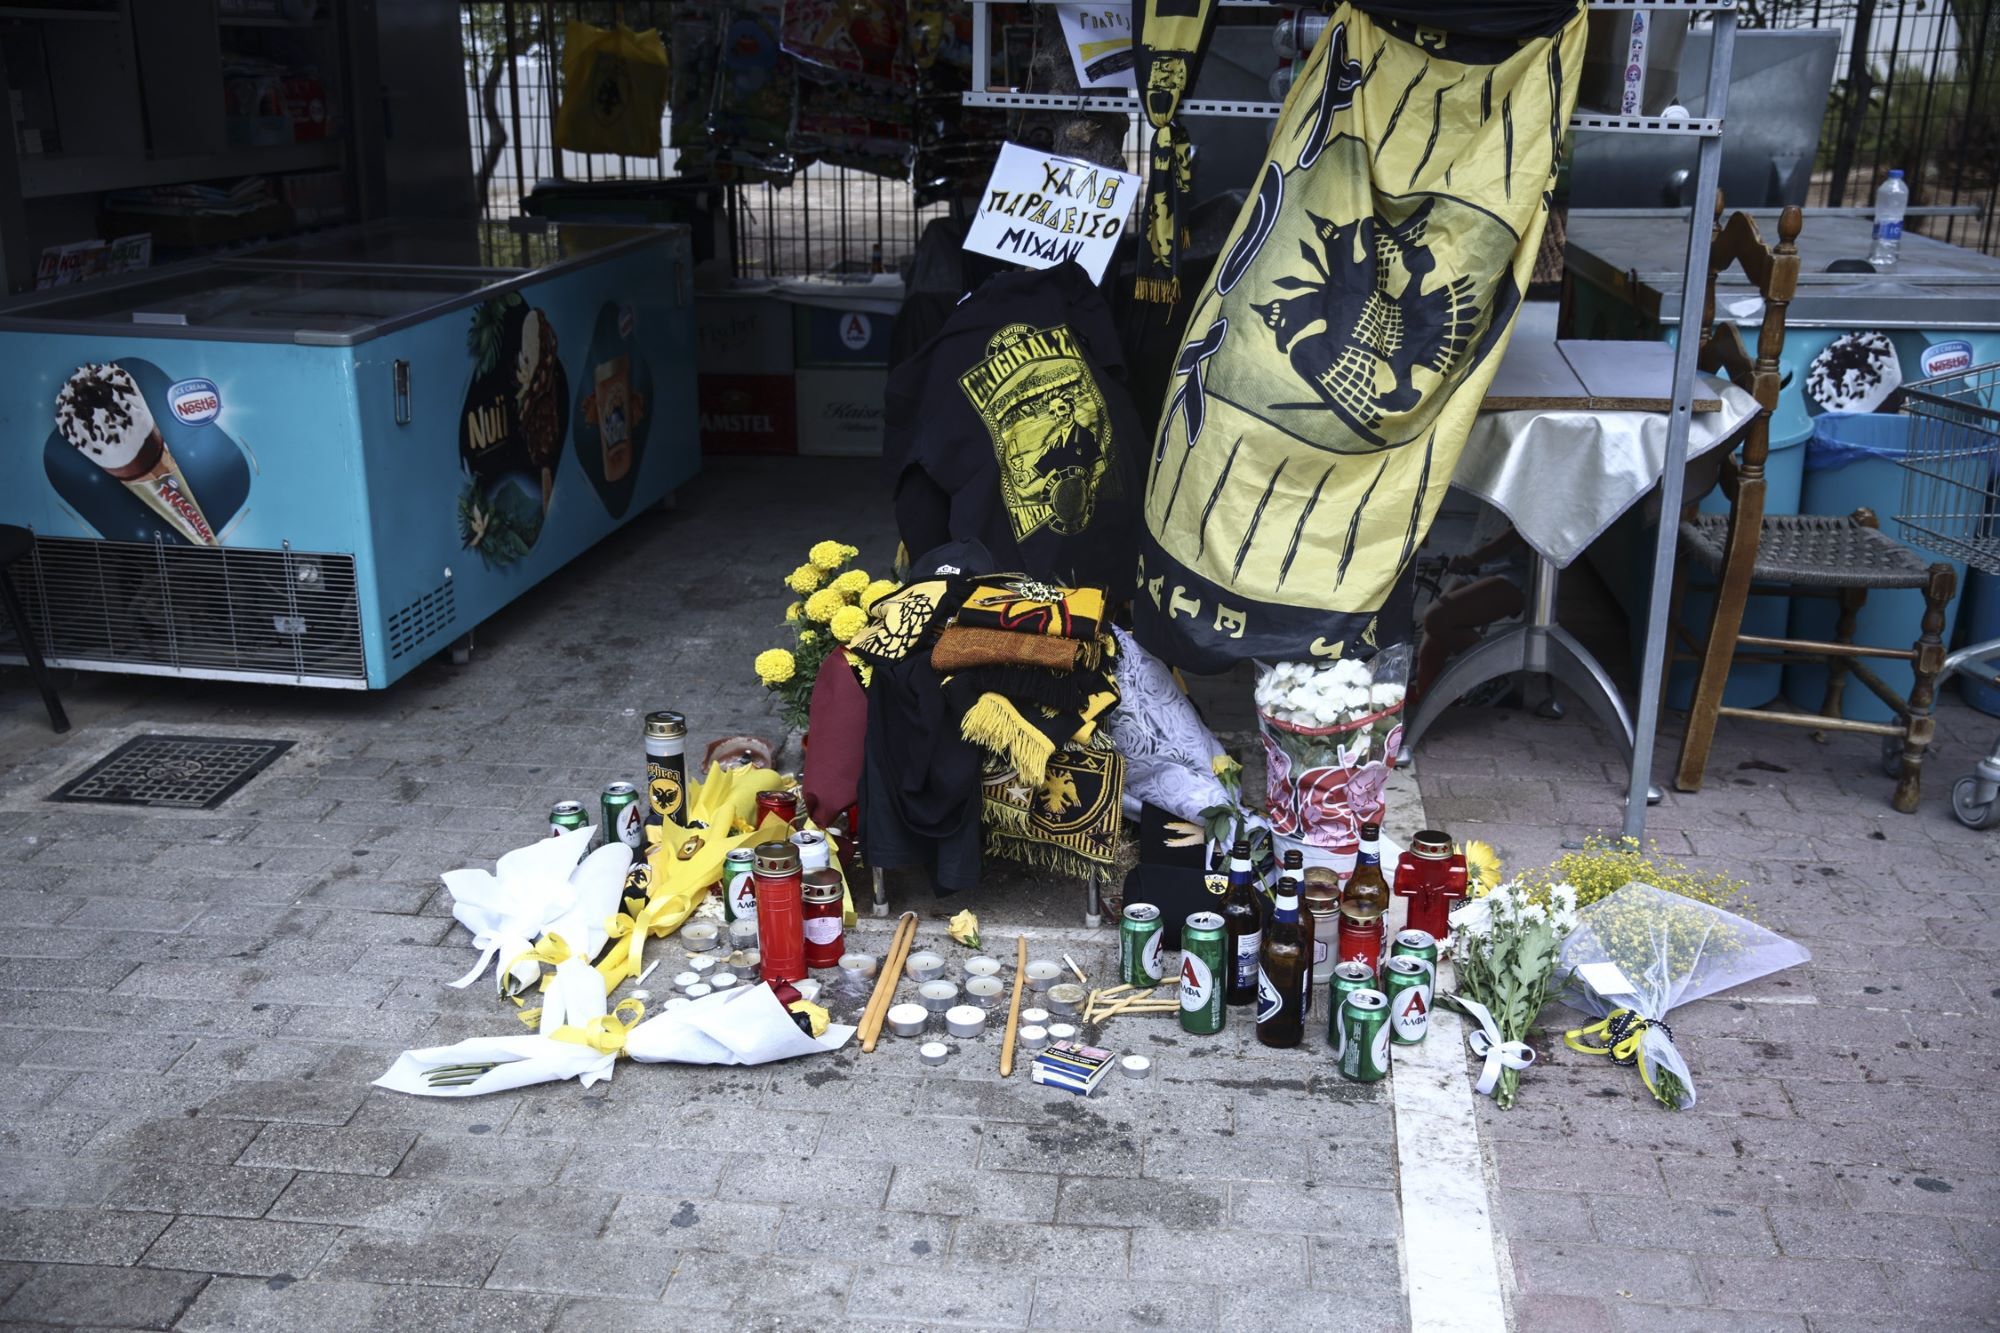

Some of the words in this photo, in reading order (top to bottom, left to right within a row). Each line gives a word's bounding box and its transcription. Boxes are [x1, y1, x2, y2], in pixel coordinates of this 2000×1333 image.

[1042, 161, 1121, 208] ΚΑΛΟ
[987, 190, 1120, 239] ΠΑΡΑΔΕΙΣΟ
[996, 227, 1085, 262] ΜΙΧΑΛΗ
[701, 415, 775, 432] AMSTEL
[737, 901, 757, 909] ΑΛΦ
